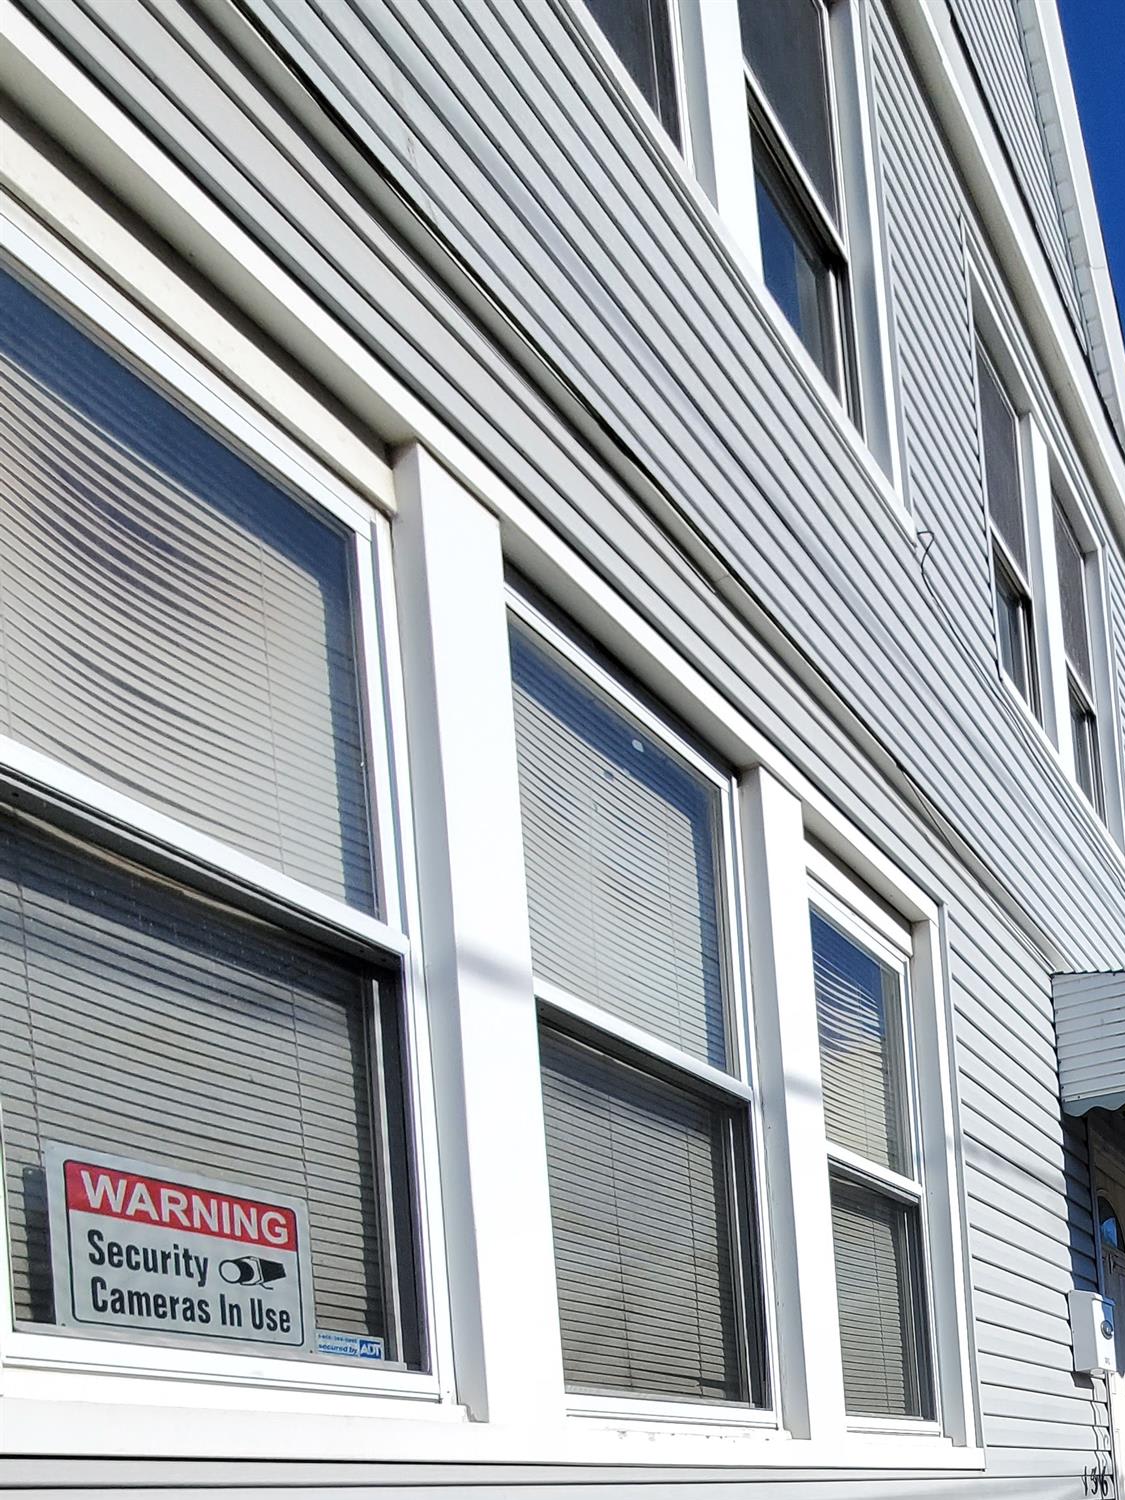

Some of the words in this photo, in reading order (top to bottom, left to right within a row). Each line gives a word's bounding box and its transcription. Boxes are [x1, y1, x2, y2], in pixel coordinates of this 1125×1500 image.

[81, 1170, 289, 1244] WARNING
[87, 1229, 209, 1287] Security
[91, 1276, 211, 1324] Cameras
[220, 1294, 242, 1327] In
[250, 1298, 291, 1333] Use
[360, 1343, 382, 1357] ADT
